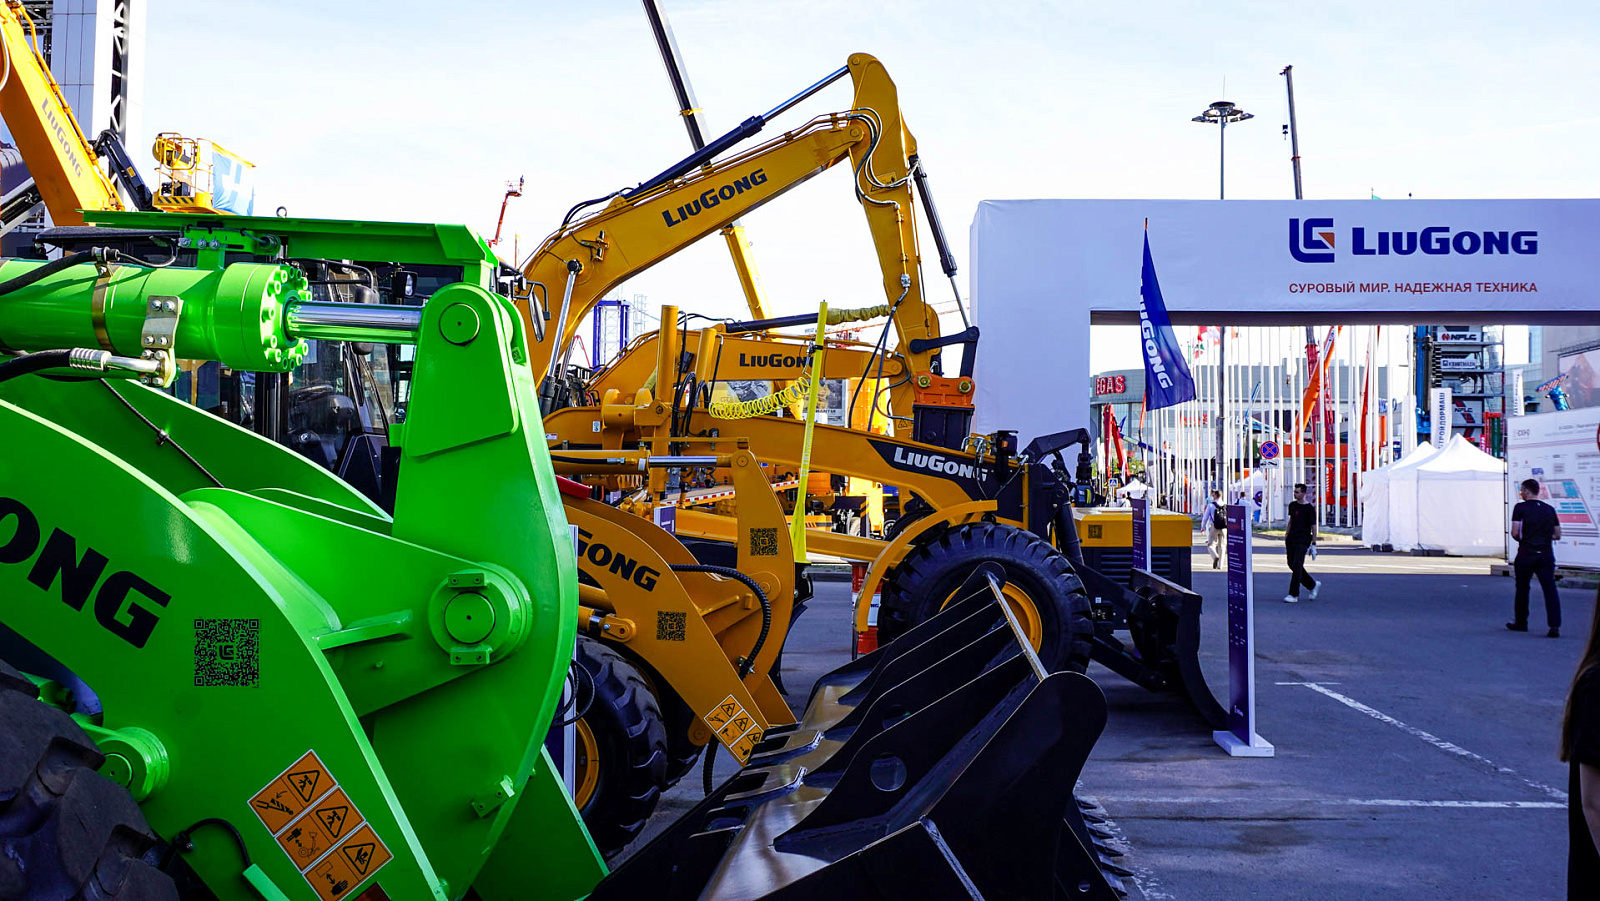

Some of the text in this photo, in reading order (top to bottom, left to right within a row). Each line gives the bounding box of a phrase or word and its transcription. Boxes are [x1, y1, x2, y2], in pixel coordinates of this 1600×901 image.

[1289, 281, 1539, 295] СУРОВЫЙ МИР. НАДЕЖНАЯ ТЕХНИКА
[739, 353, 814, 368] LIUGON
